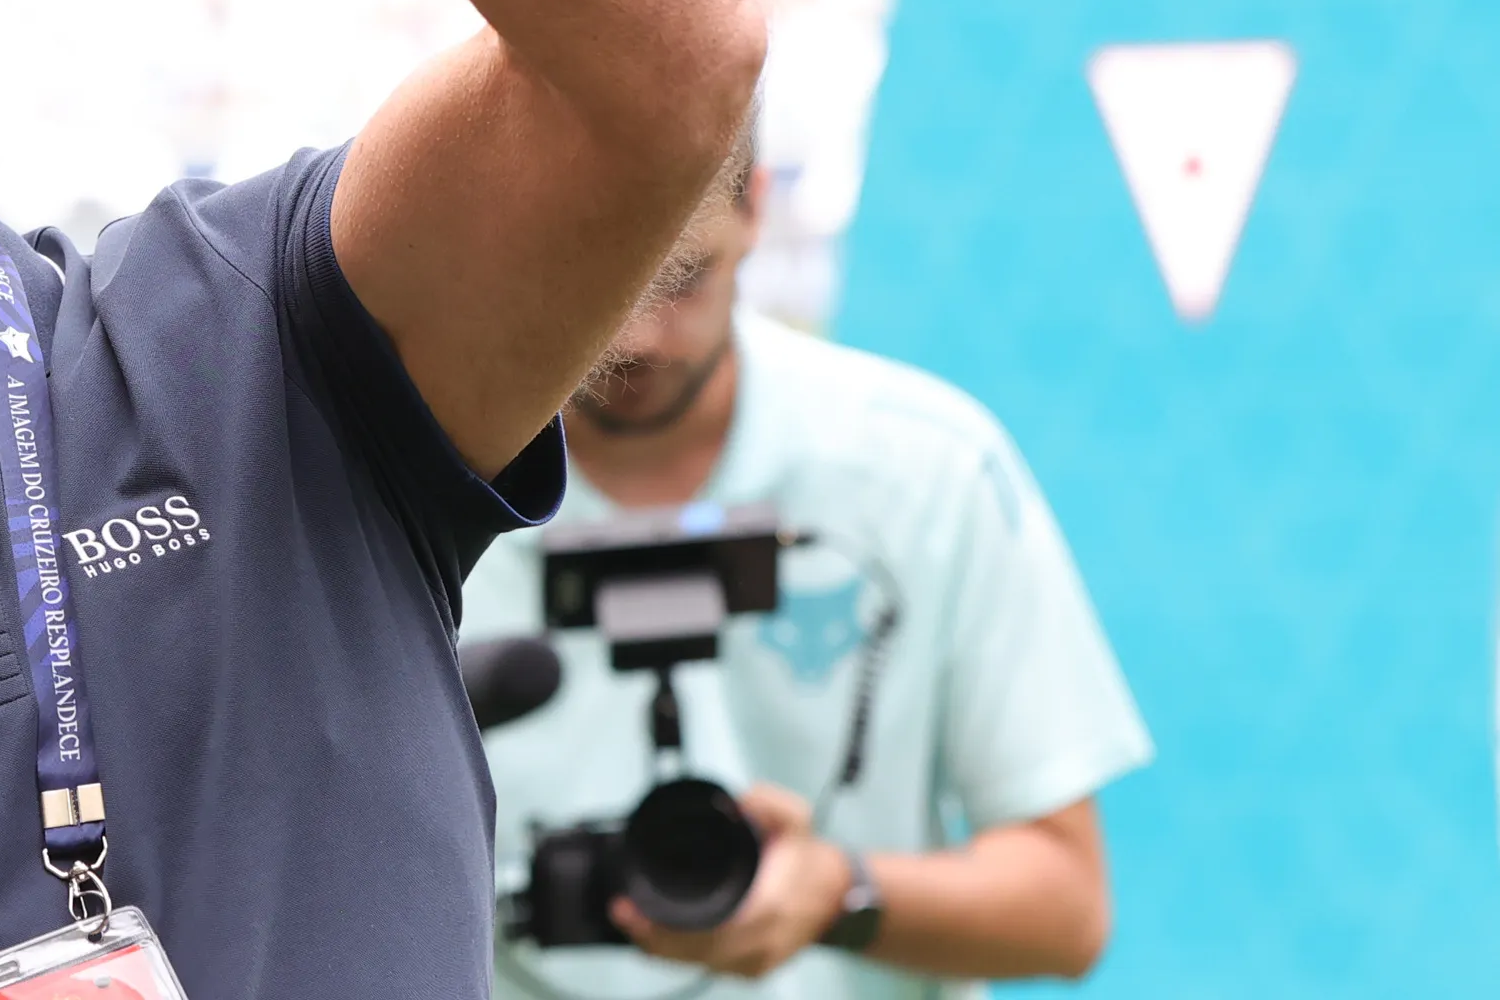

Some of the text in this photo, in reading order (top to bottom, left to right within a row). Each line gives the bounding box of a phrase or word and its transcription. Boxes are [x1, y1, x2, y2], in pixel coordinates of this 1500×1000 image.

[62, 496, 200, 564] BOSS
[83, 528, 210, 578] HUGO BOSS
[7, 374, 80, 762] A IMAGEM DO CRUZEIRO RESPLANDECE
